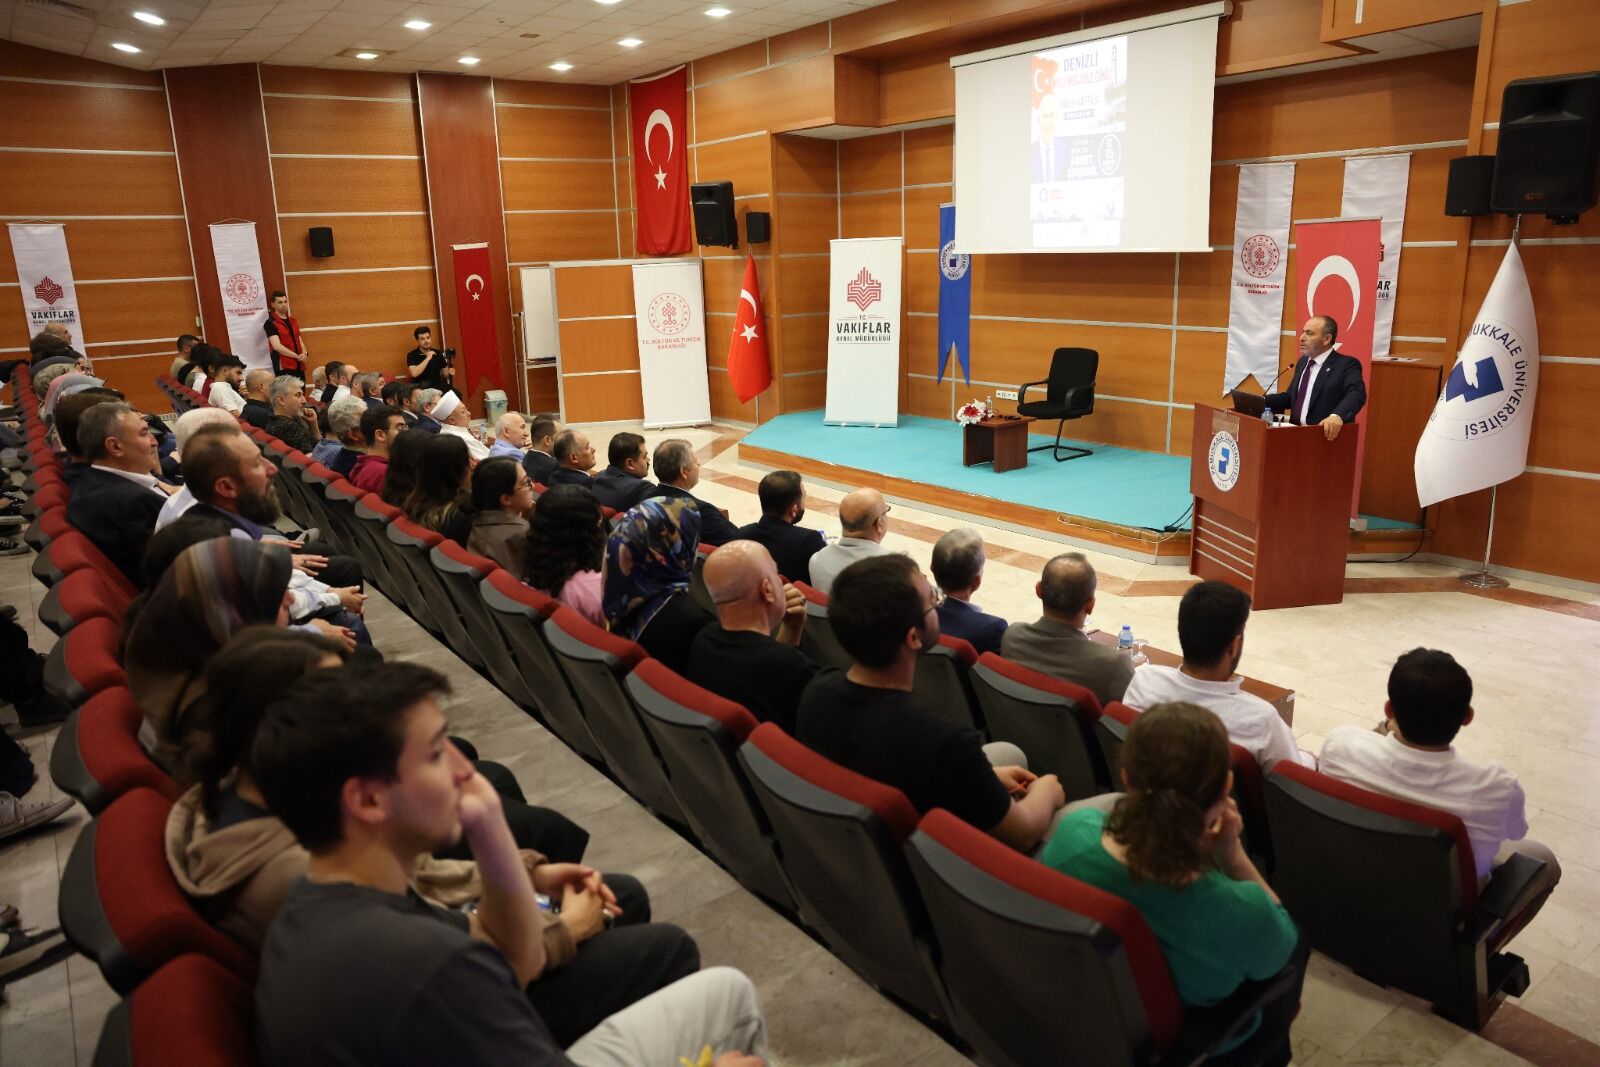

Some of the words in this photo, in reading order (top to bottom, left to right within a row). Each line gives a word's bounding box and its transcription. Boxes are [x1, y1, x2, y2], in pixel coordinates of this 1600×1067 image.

[1063, 50, 1098, 72] DENİZLİ
[31, 310, 75, 320] VAKIFLAR
[836, 321, 891, 334] VAKIFLAR
[1467, 323, 1522, 357] UKKALE
[1464, 360, 1528, 439] ÜNİVERSİTESİ
